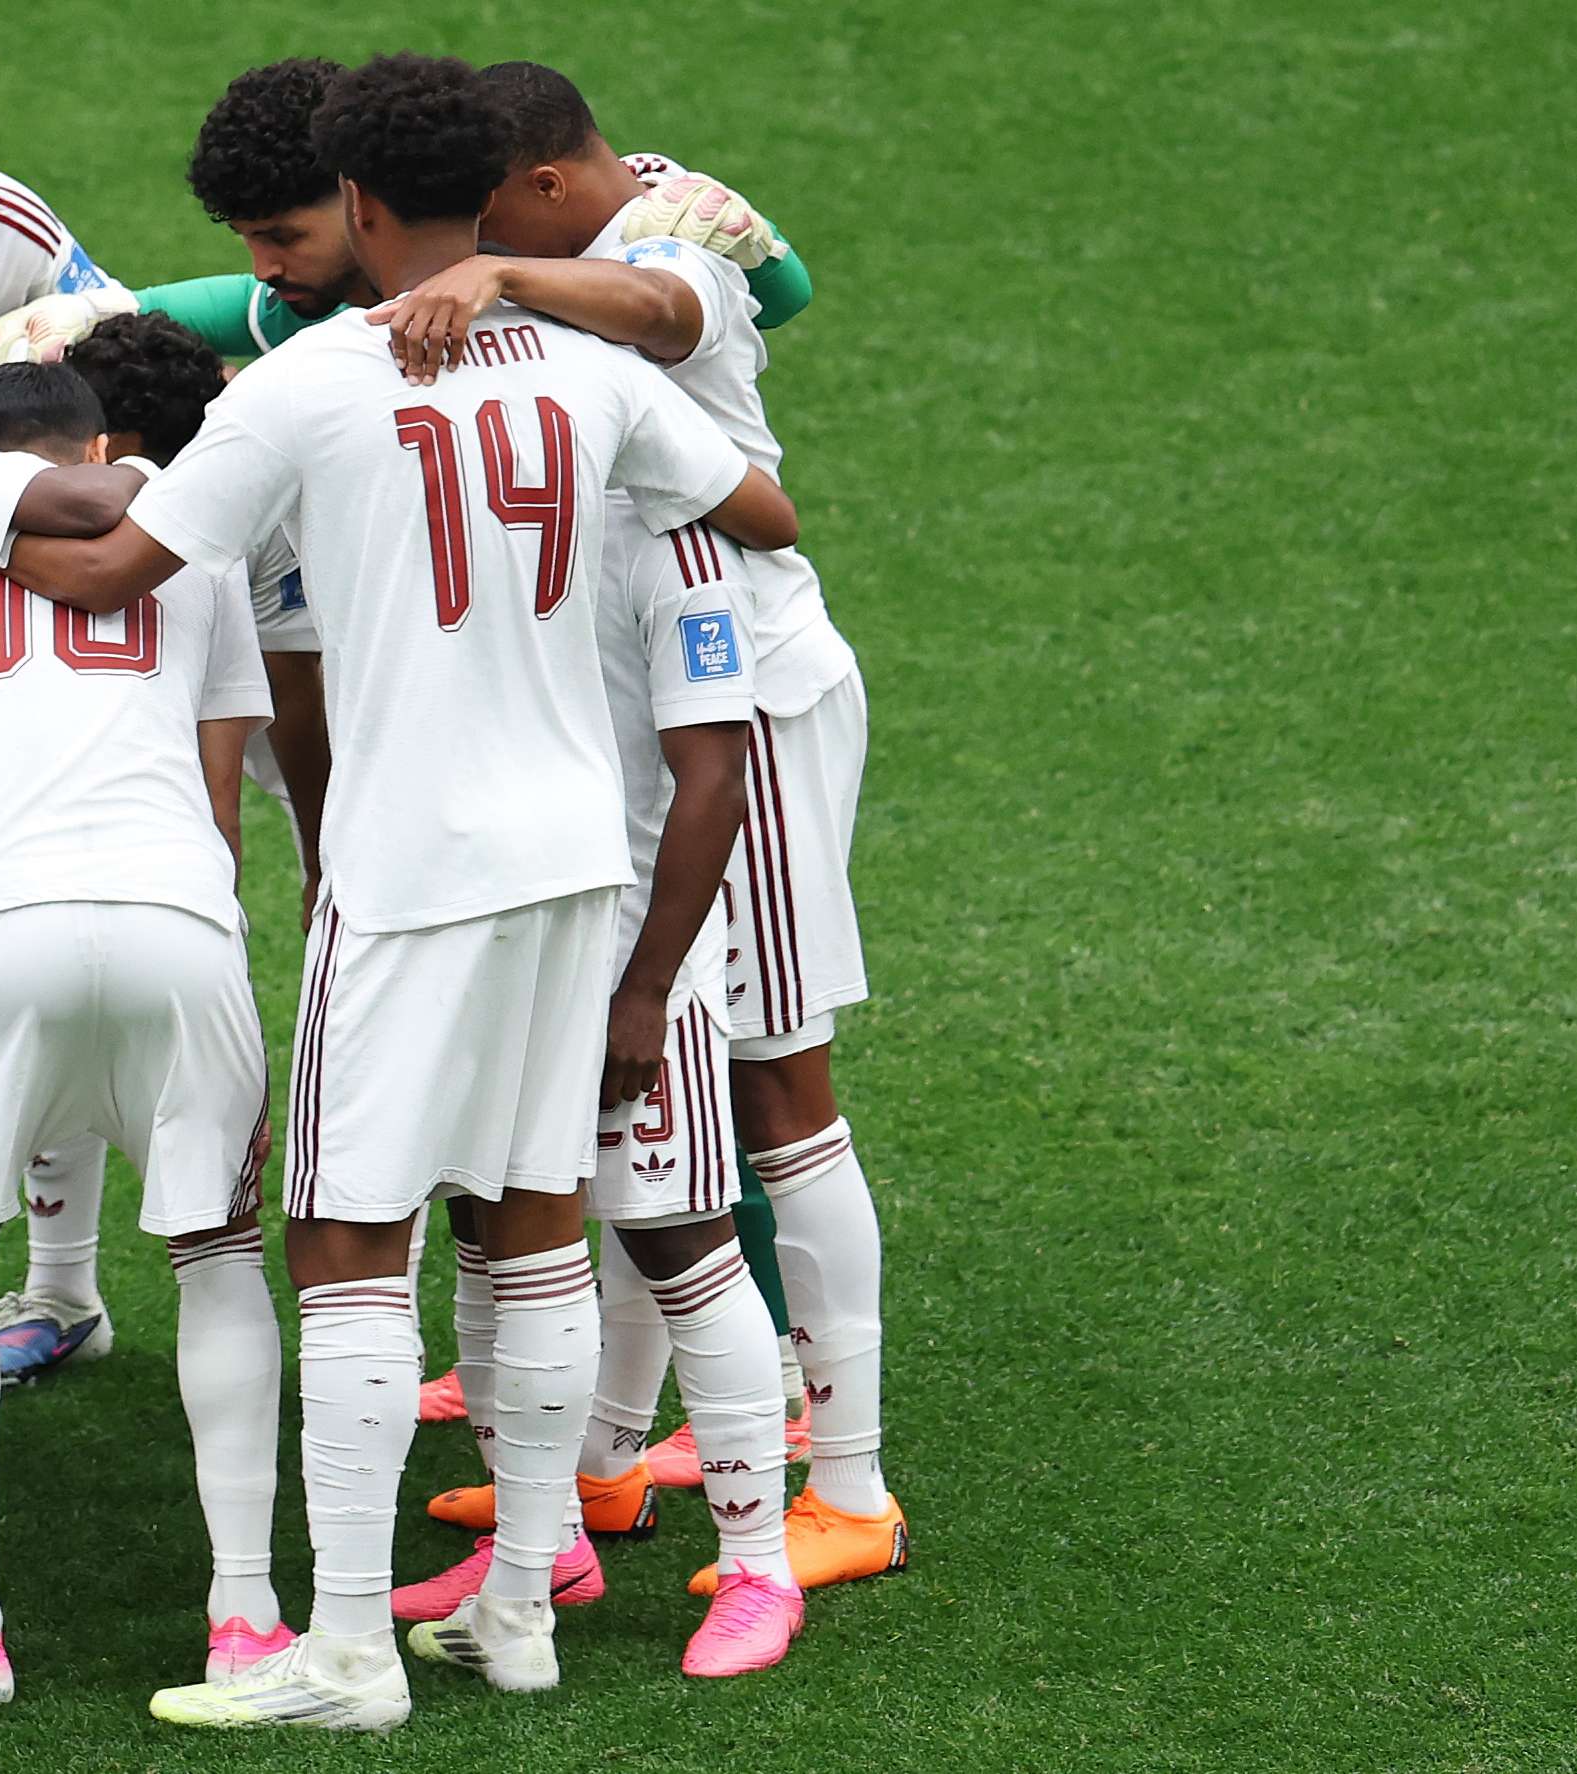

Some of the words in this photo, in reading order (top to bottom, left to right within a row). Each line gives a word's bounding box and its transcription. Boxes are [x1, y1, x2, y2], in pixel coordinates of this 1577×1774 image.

[394, 396, 579, 633] 14
[699, 651, 729, 667] PEACE
[700, 1459, 752, 1474] QFA
